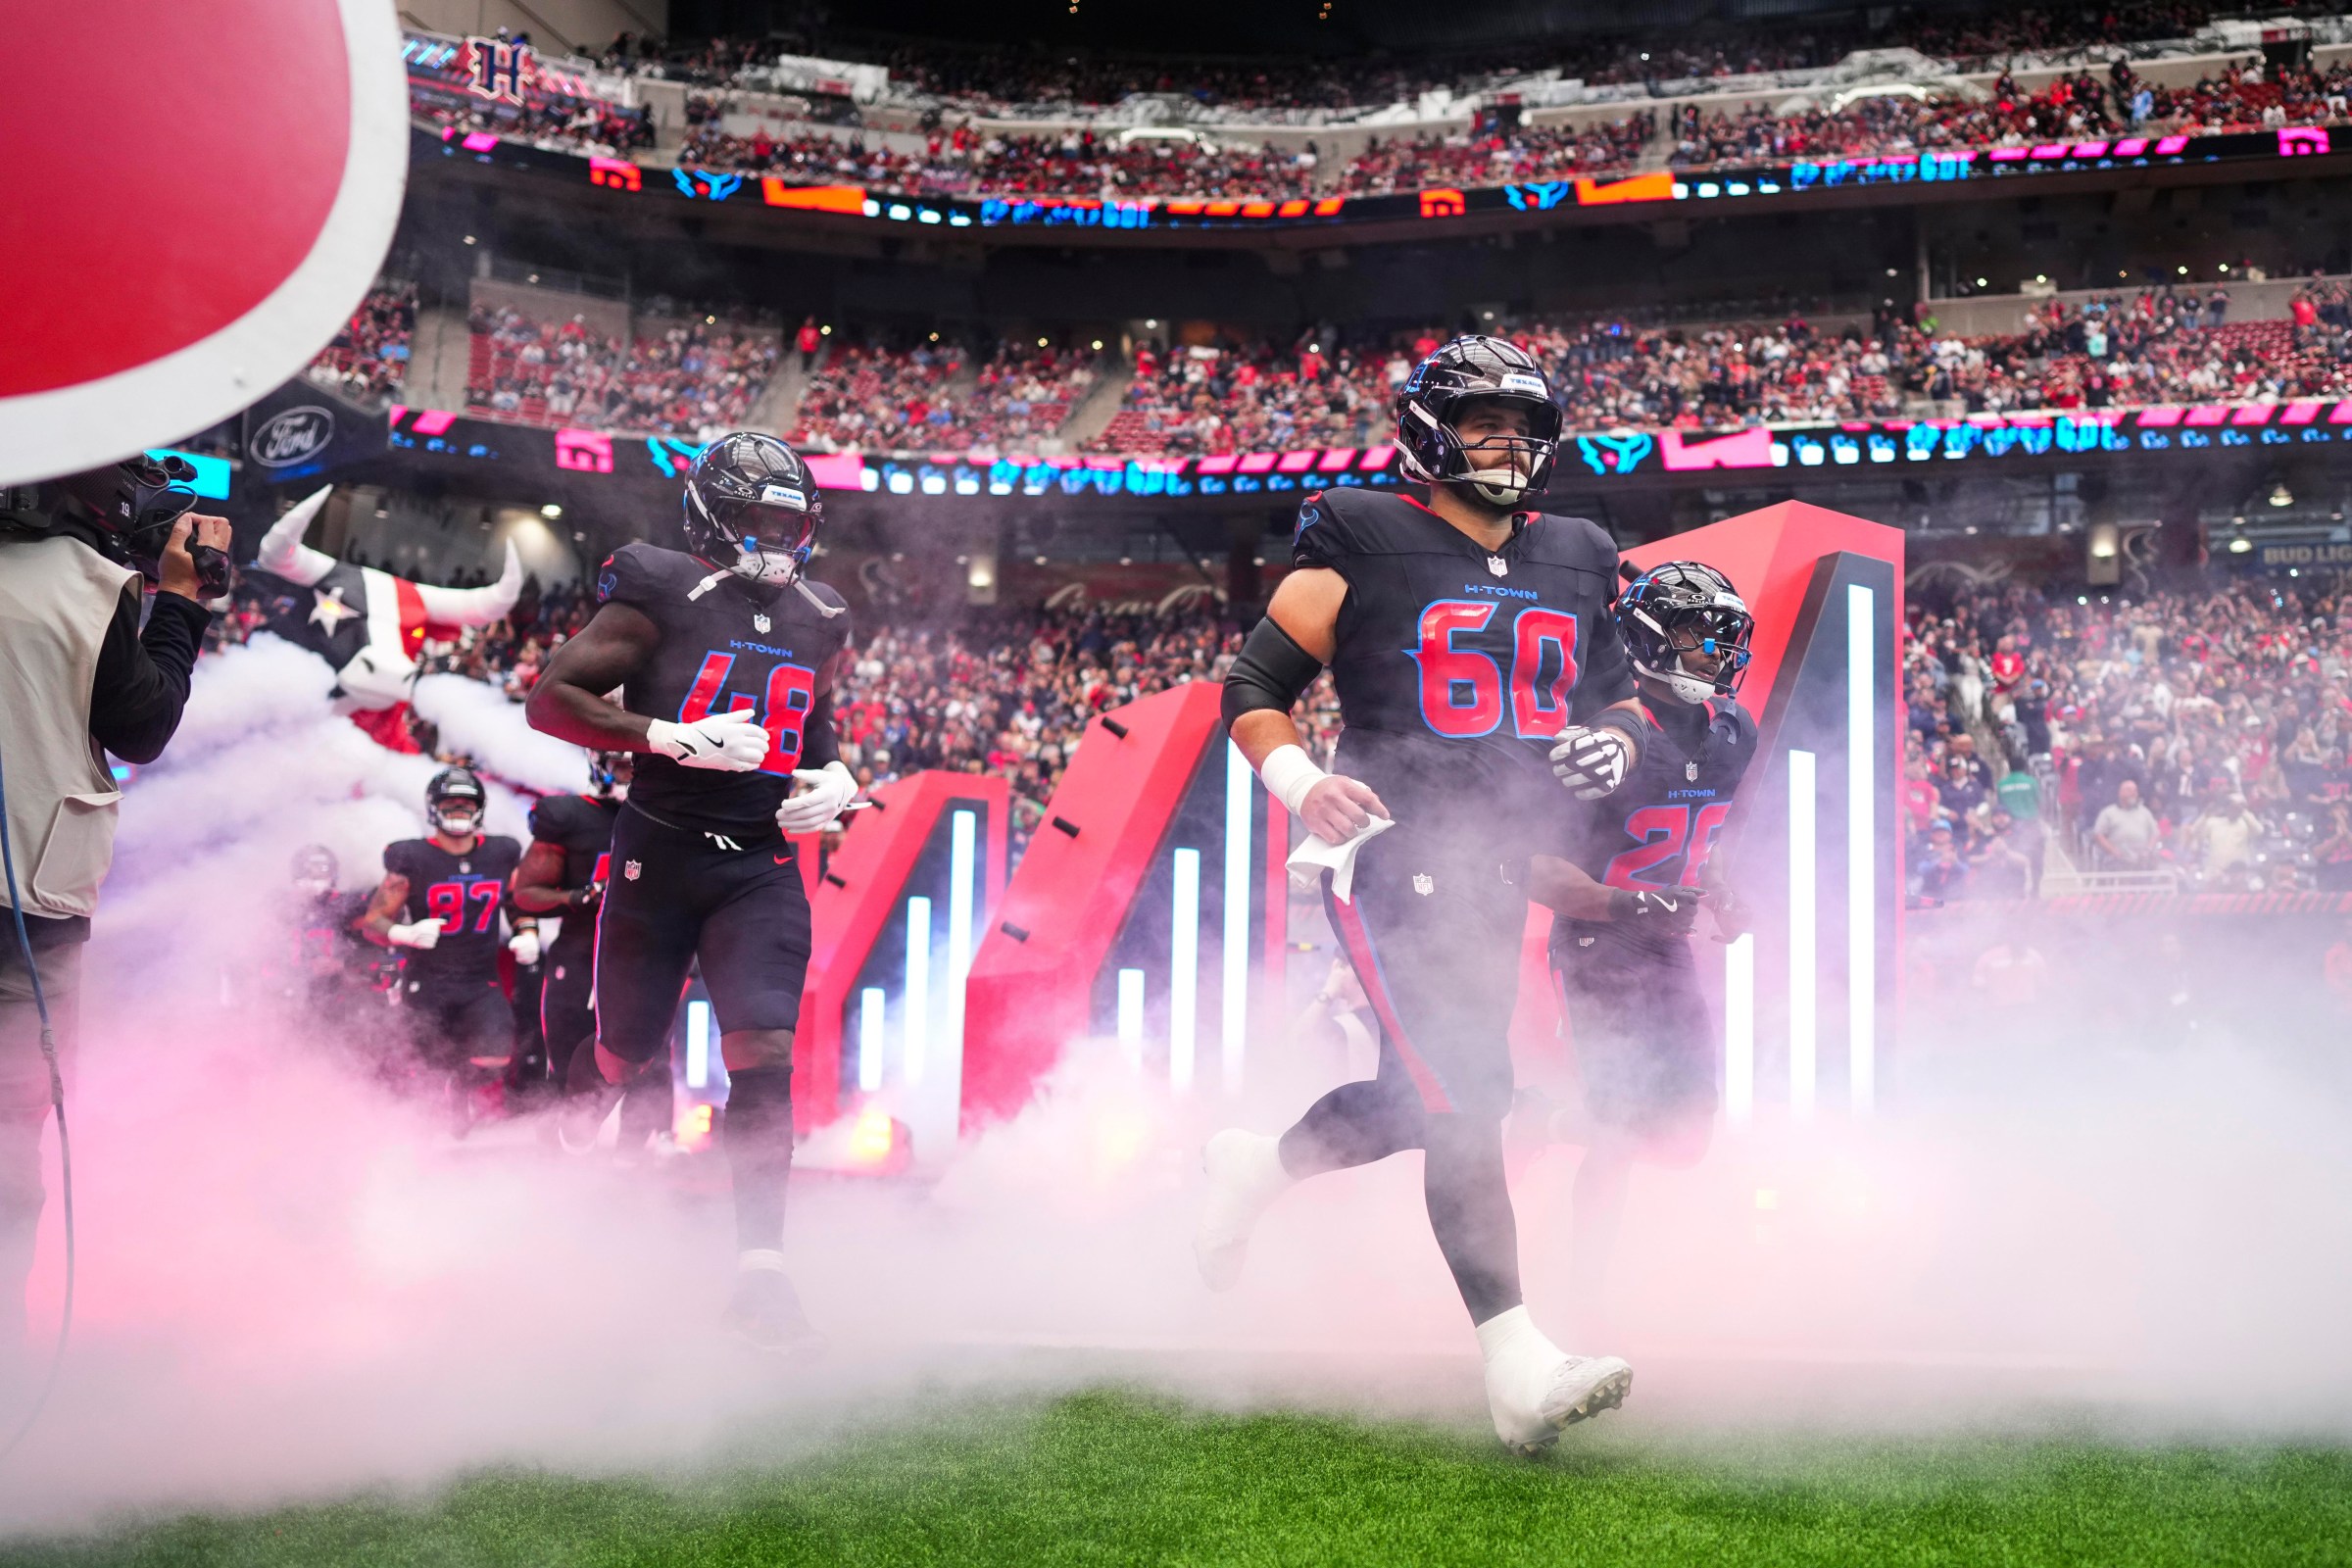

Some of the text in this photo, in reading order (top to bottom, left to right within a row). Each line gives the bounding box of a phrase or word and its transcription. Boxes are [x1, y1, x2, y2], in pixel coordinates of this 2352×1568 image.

[265, 414, 319, 459] Ford
[120, 501, 130, 516] 19
[2264, 546, 2313, 564] BUD
[1464, 584, 1539, 601] H-TOWN
[729, 640, 793, 658] H-TOWN
[1401, 599, 1578, 741] 60
[677, 650, 815, 777] 48
[1668, 789, 1716, 799] H-TOWN
[426, 880, 502, 933] 87
